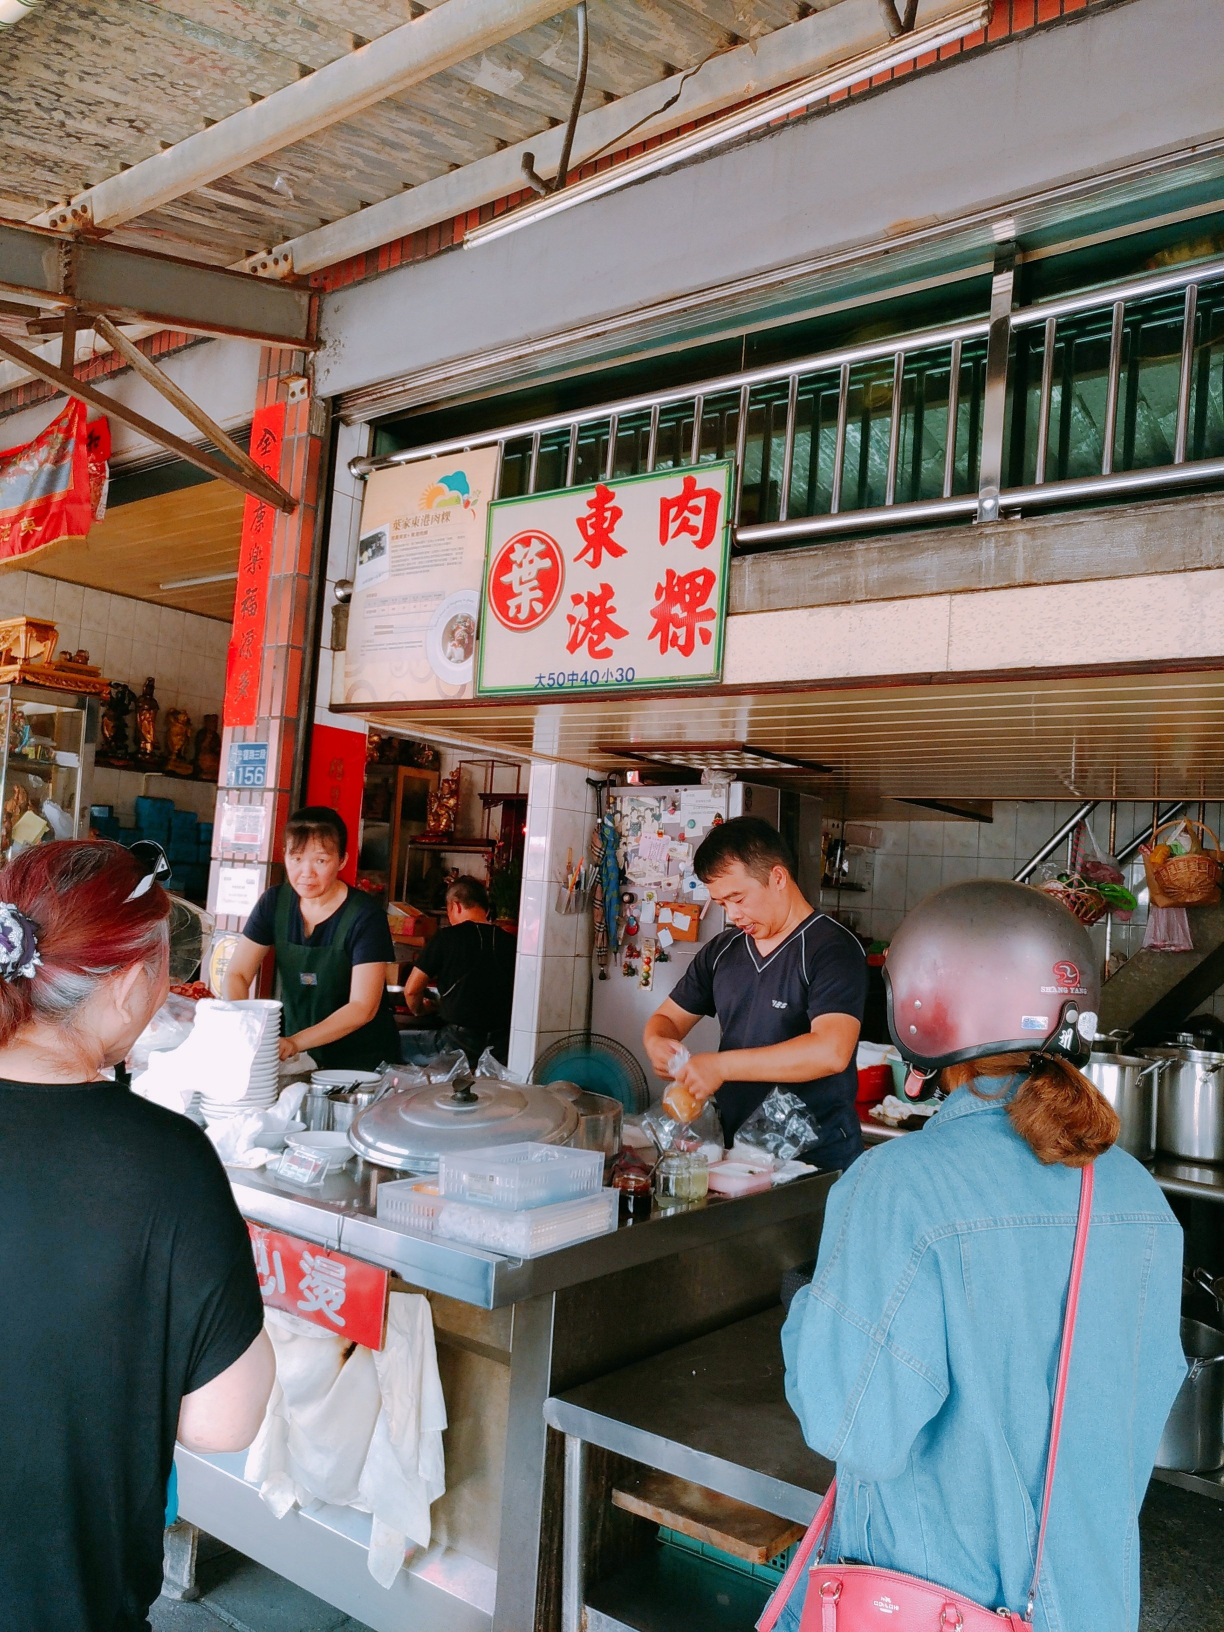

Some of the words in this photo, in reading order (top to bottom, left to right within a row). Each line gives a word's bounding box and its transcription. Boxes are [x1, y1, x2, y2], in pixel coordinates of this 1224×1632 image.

[392, 510, 452, 531] 葉家東港肉粿
[499, 537, 552, 621] 葉
[238, 766, 265, 785] 156
[1040, 985, 1069, 994] SHANG
[1069, 987, 1088, 995] YANG
[873, 1600, 900, 1611] COACH
